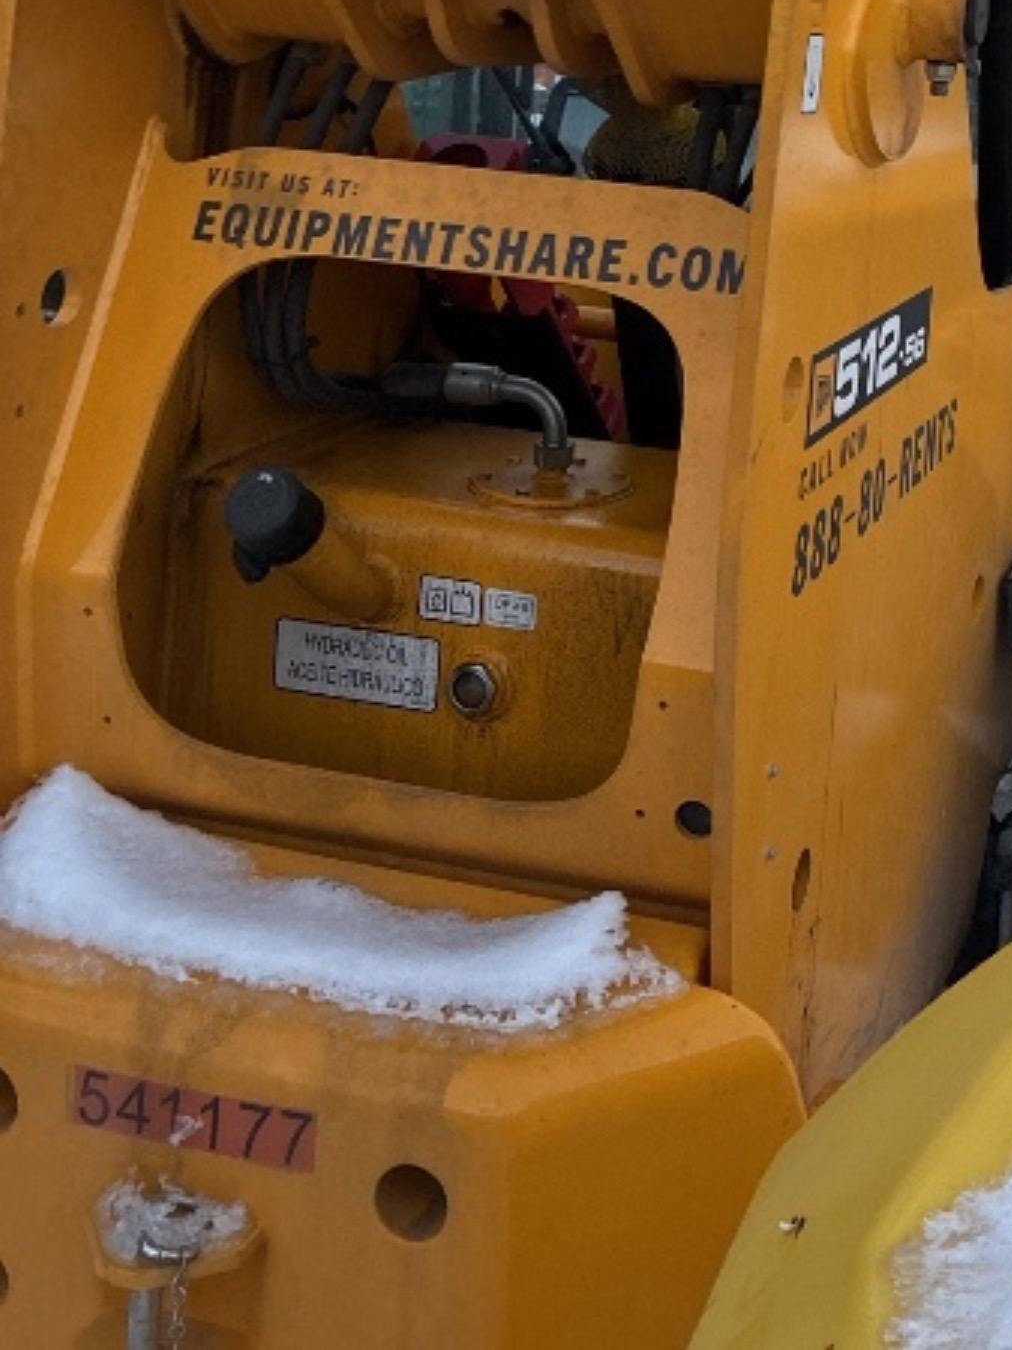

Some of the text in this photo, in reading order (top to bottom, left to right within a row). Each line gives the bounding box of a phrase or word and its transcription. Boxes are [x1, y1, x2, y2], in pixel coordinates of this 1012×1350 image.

[207, 167, 361, 199] VISIT US AT:
[791, 399, 958, 598] 888-80-RENTS
[799, 449, 832, 501] CALL
[78, 1068, 313, 1167] 541177
